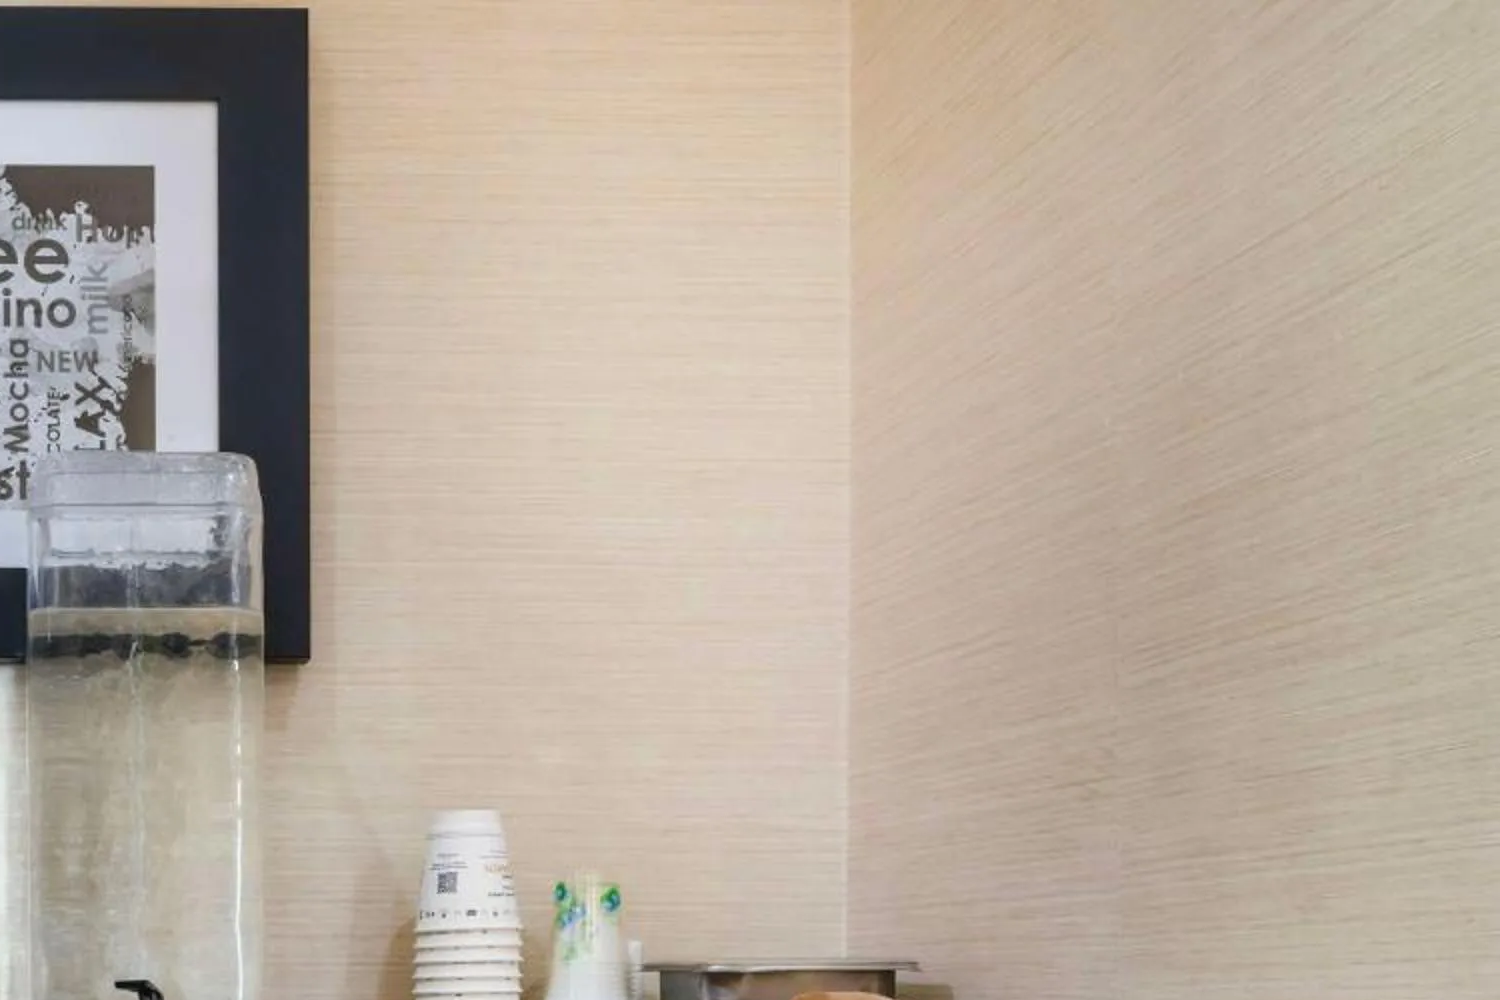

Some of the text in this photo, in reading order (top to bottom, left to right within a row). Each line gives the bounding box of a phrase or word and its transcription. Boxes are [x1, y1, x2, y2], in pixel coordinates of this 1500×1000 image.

[80, 262, 108, 334] milk
[3, 338, 30, 453] Mocha
[36, 350, 99, 373] NEW
